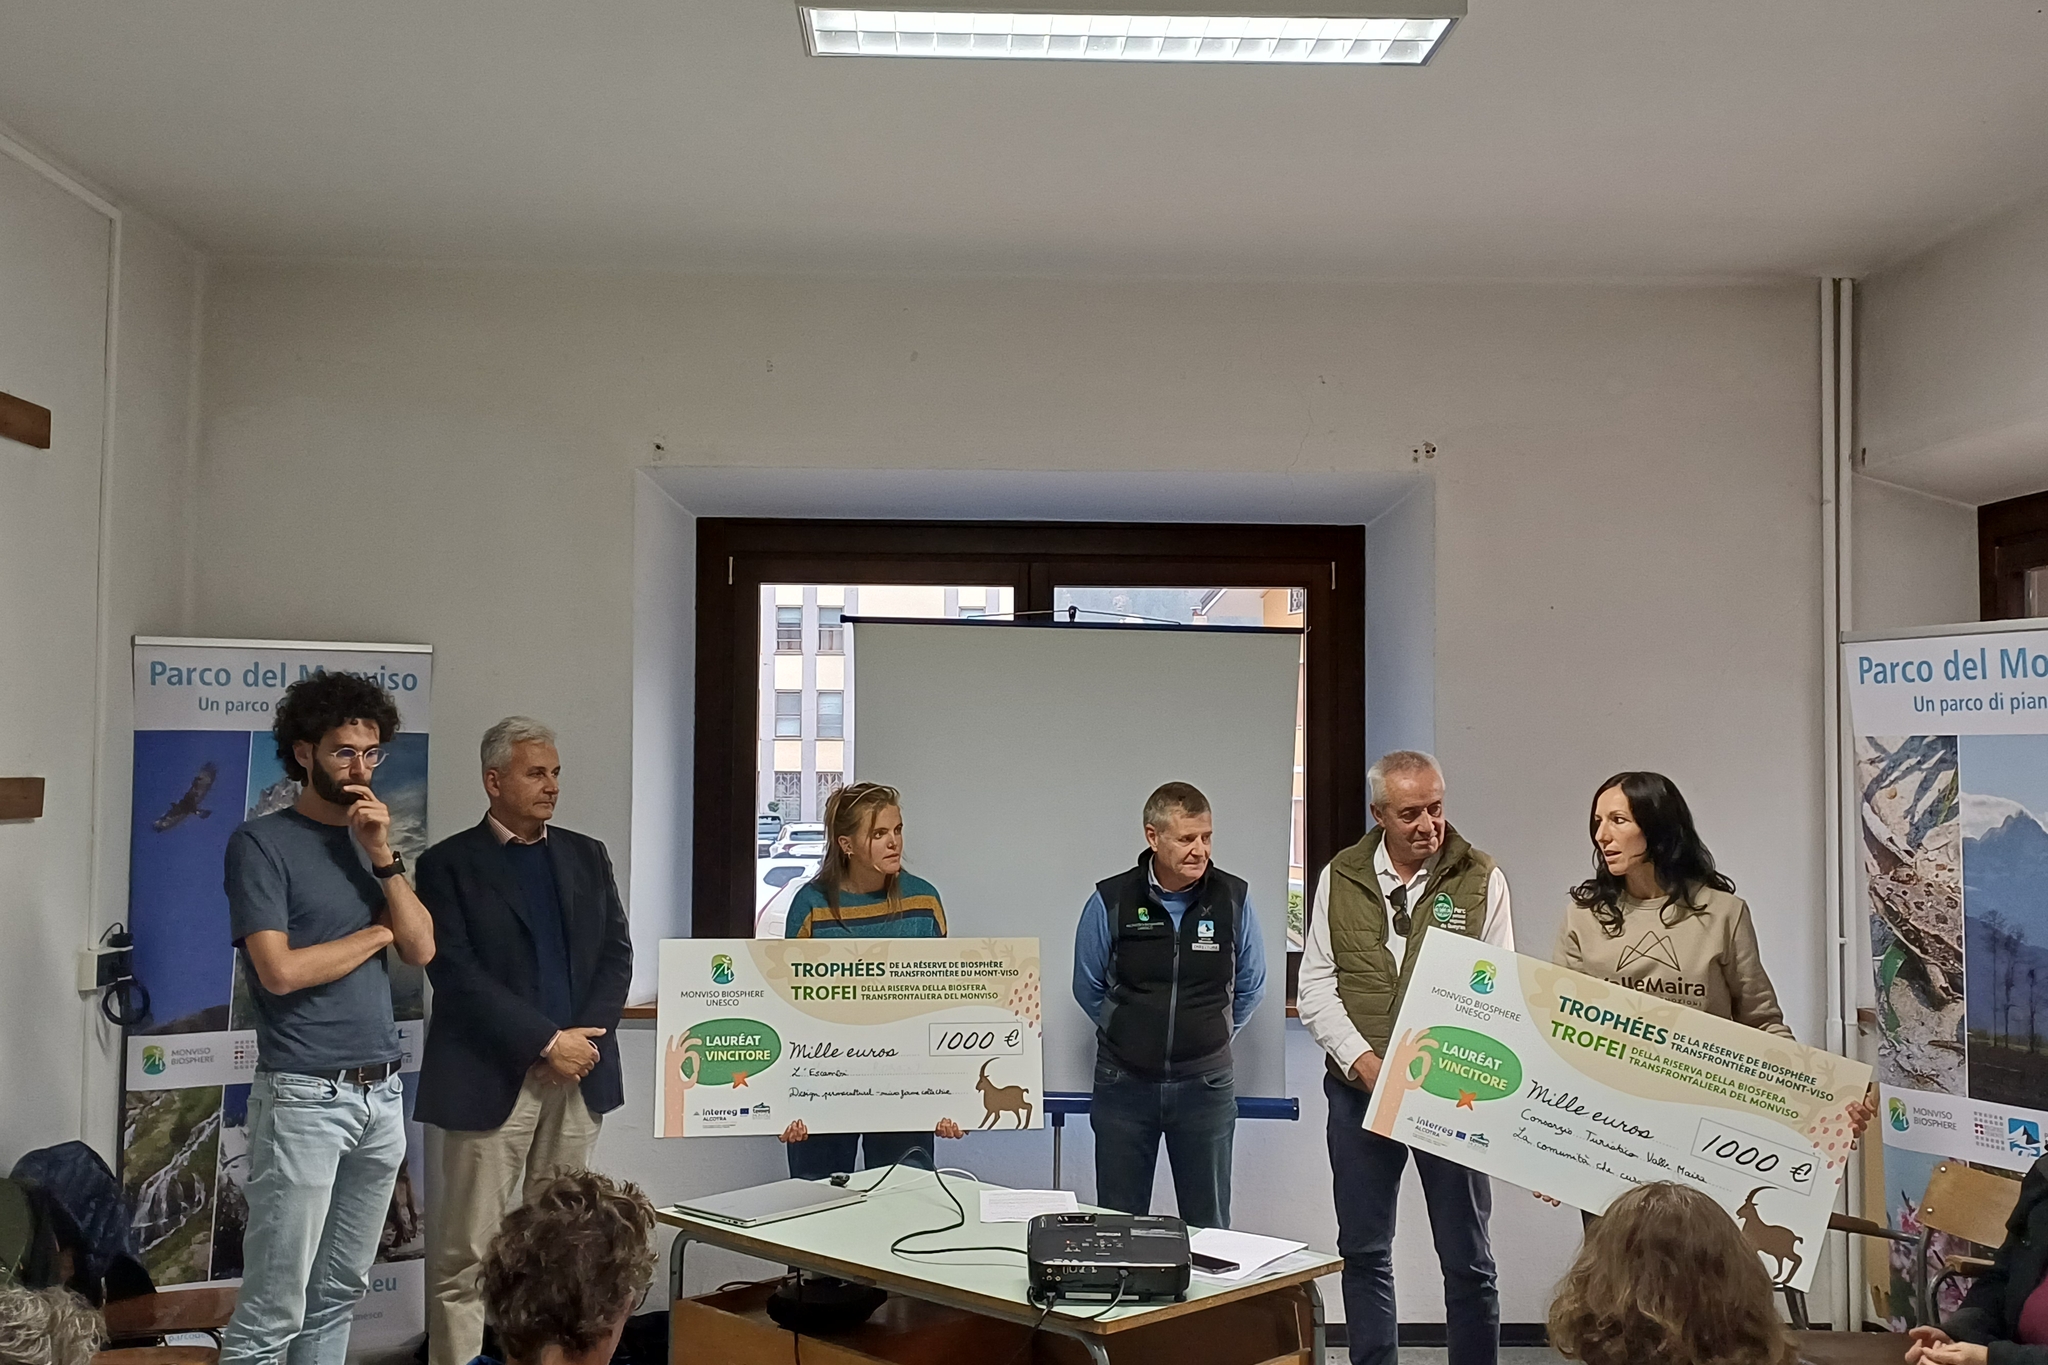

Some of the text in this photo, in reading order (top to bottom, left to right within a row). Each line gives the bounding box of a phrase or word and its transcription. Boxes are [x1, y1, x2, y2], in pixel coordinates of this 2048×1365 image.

[150, 660, 232, 687] Parco
[242, 661, 287, 688] del
[1859, 656, 1933, 685] Parco
[1943, 647, 1988, 682] del
[198, 697, 220, 711] Un
[225, 699, 270, 715] parco
[1914, 691, 2048, 716] Un parco di pian
[791, 959, 886, 978] TROPHÉES
[890, 969, 959, 978] TRANSFRONTIÈRE
[974, 969, 1019, 977] MONT-VISO
[914, 960, 947, 969] RÉSERVE
[961, 960, 1003, 968] BIOSPHÈRE
[680, 990, 765, 998] MONVISO BIOSPHERE
[791, 985, 857, 1000] TROFEI
[861, 984, 886, 993] DELLA
[888, 984, 920, 992] RISERVA
[922, 984, 947, 992] DELLA
[861, 992, 941, 1001] TRANSFRONTALIERA
[960, 992, 999, 1000] MONVISO
[706, 998, 740, 1006] UNESCO
[1431, 986, 1522, 1022] MONVISO BIOSPHERE
[1455, 1003, 1491, 1022] UNESCO
[1559, 995, 1669, 1045] TROPHÉES
[706, 1033, 762, 1047] LAURÉAT
[936, 1029, 1020, 1050] 1000 €
[1551, 1019, 1628, 1060] TROFEI
[171, 1047, 212, 1057] MONVISO
[705, 1050, 771, 1061] VINCITORE
[789, 1041, 900, 1060] Mille euros
[1442, 1041, 1502, 1071] LAURÉAT
[1672, 1032, 1818, 1086] DE LA RÉSERVE DE BIOSPHÈRE
[171, 1055, 215, 1066] BIOSPHERE
[1438, 1057, 1509, 1091] VINCITORE
[1631, 1046, 1787, 1105] DELLA RISERVA DELLA BIOSFERA
[1670, 1042, 1835, 1102] TRANSFRONTIÈRE DU MONT-VISO
[1628, 1056, 1800, 1119] TRANSFRONTALIERA DEL MONVISO
[702, 1108, 738, 1117] Interreg
[1527, 1079, 1655, 1140] Mille euros
[1912, 1106, 1953, 1120] MONVISO
[1520, 1108, 1573, 1136] Consorzio
[1913, 1116, 1957, 1131] BIOSPHERE
[1512, 1126, 1533, 1145] La
[1701, 1134, 1813, 1183] 1000 €
